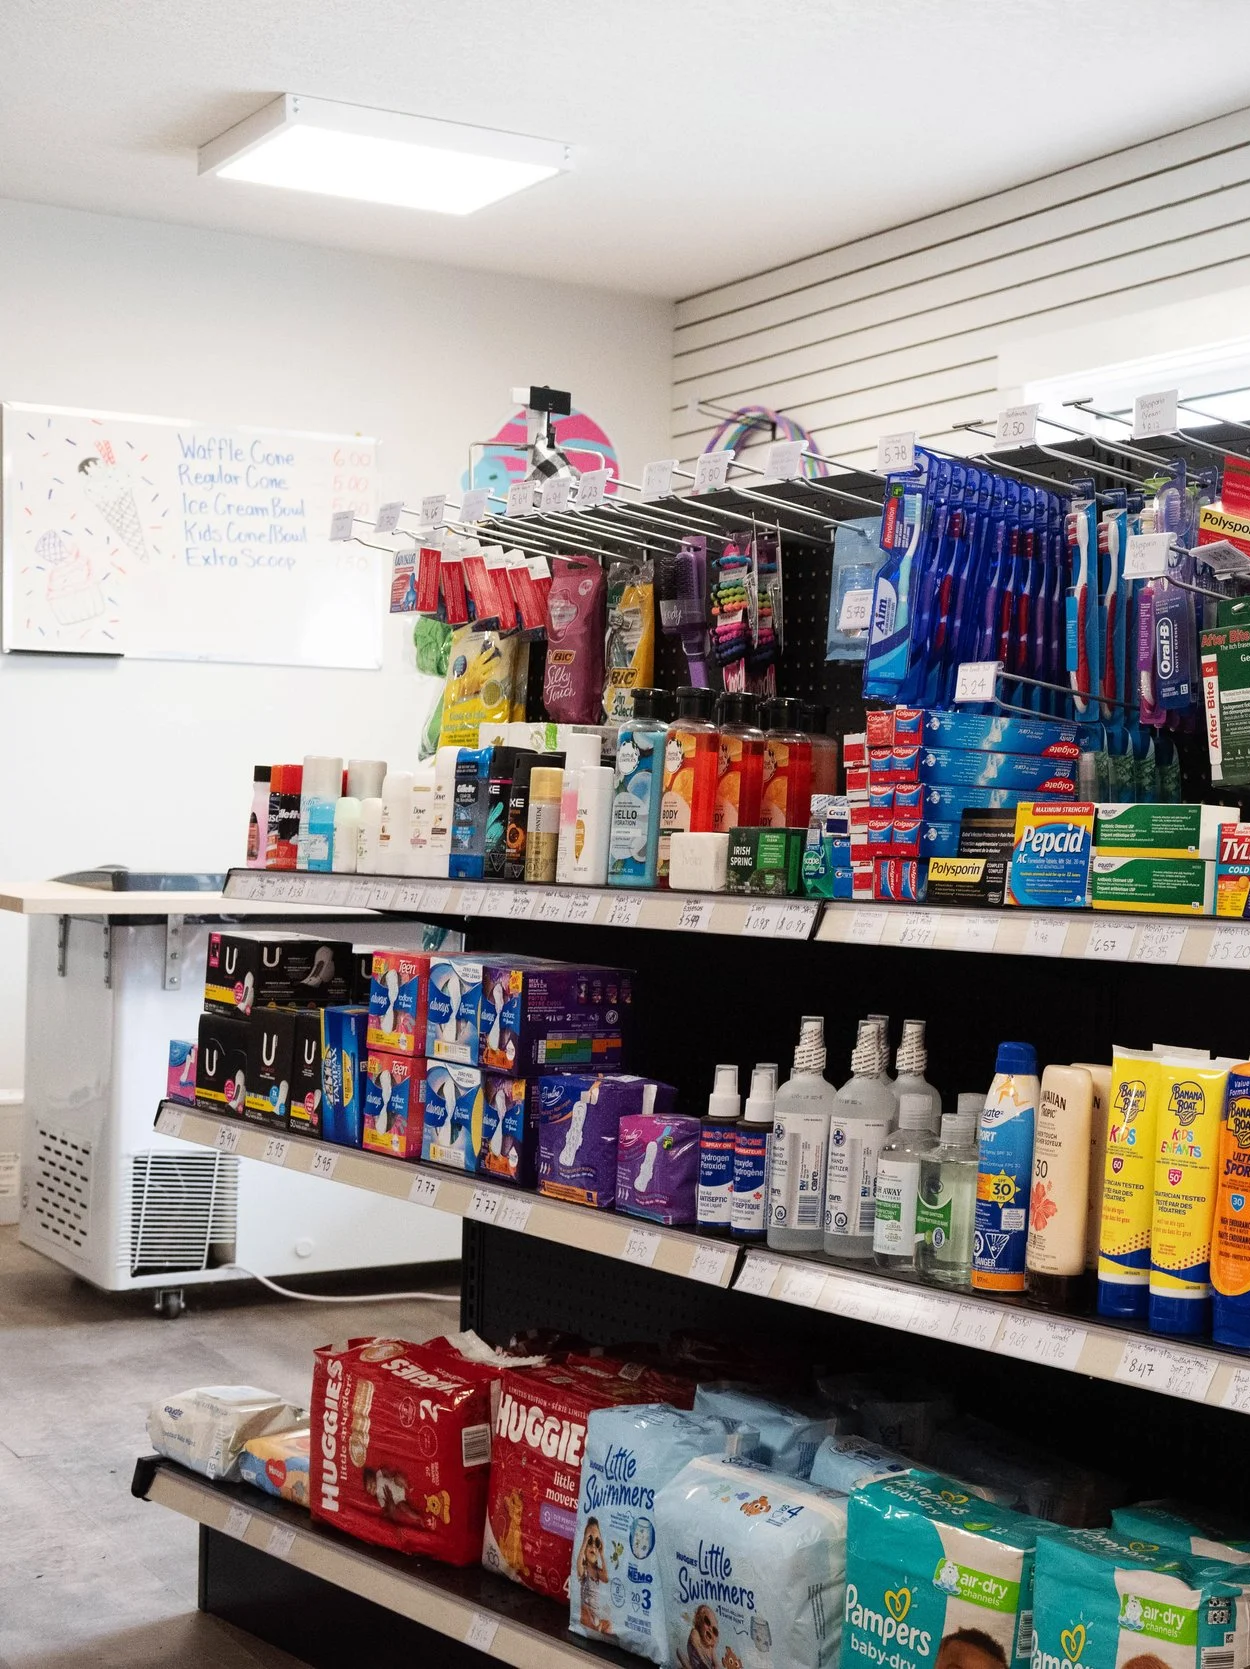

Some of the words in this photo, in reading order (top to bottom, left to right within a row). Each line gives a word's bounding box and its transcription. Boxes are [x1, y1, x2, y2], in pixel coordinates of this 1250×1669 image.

[1001, 421, 1025, 437] 2.50
[177, 433, 244, 463] Waffle
[250, 440, 295, 466] Cone
[882, 445, 907, 464] 5.78
[178, 463, 241, 491] Regular
[245, 464, 290, 491] Cone
[182, 492, 208, 515] Ice
[214, 492, 269, 517] Cream
[184, 520, 223, 543] Kids
[884, 505, 897, 546] Revolution
[186, 547, 238, 567] Extra
[241, 548, 297, 571] Scoop
[874, 598, 889, 634] Aim
[1160, 621, 1172, 674] Oral-B
[1201, 632, 1228, 648] After
[1229, 631, 1250, 643] Bite
[552, 652, 573, 662] BIC
[547, 664, 572, 687] Silky
[611, 669, 636, 685] BIC
[547, 682, 575, 706] Touch
[961, 679, 988, 697] 5.24
[896, 709, 920, 718] Colgate
[615, 809, 638, 821] HELLO
[663, 809, 679, 820] BODY
[829, 808, 847, 818] Crest
[1035, 806, 1060, 814] MAXIMUM
[1061, 806, 1090, 814] STRENGTH
[1018, 825, 1084, 856] Pepcid
[733, 846, 751, 857] IRISH
[1016, 853, 1027, 864] AC
[730, 856, 753, 868] SPRING
[803, 857, 820, 866] scope
[930, 861, 982, 877] Polysporin
[1228, 866, 1250, 875] COLD
[398, 959, 416, 975] Teen
[331, 1048, 340, 1106] TAMPAX
[1235, 1079, 1250, 1087] Value
[1173, 1086, 1203, 1101] BANANA
[1160, 1141, 1203, 1159] ENFANTS
[1035, 1159, 1048, 1179] 30
[1111, 1160, 1123, 1171] 60
[1168, 1172, 1181, 1184] 50
[992, 1183, 1012, 1195] 30
[321, 1358, 344, 1513] HUGGIES
[603, 1443, 637, 1484] Little
[553, 1471, 576, 1492] little
[545, 1487, 580, 1509] movers
[583, 1473, 655, 1515] Swimmers
[698, 1540, 733, 1578] Little
[678, 1568, 755, 1613] Swimmers
[960, 1570, 1008, 1600] air-dry
[962, 1589, 1002, 1606] channels
[845, 1584, 931, 1657] Pampers
